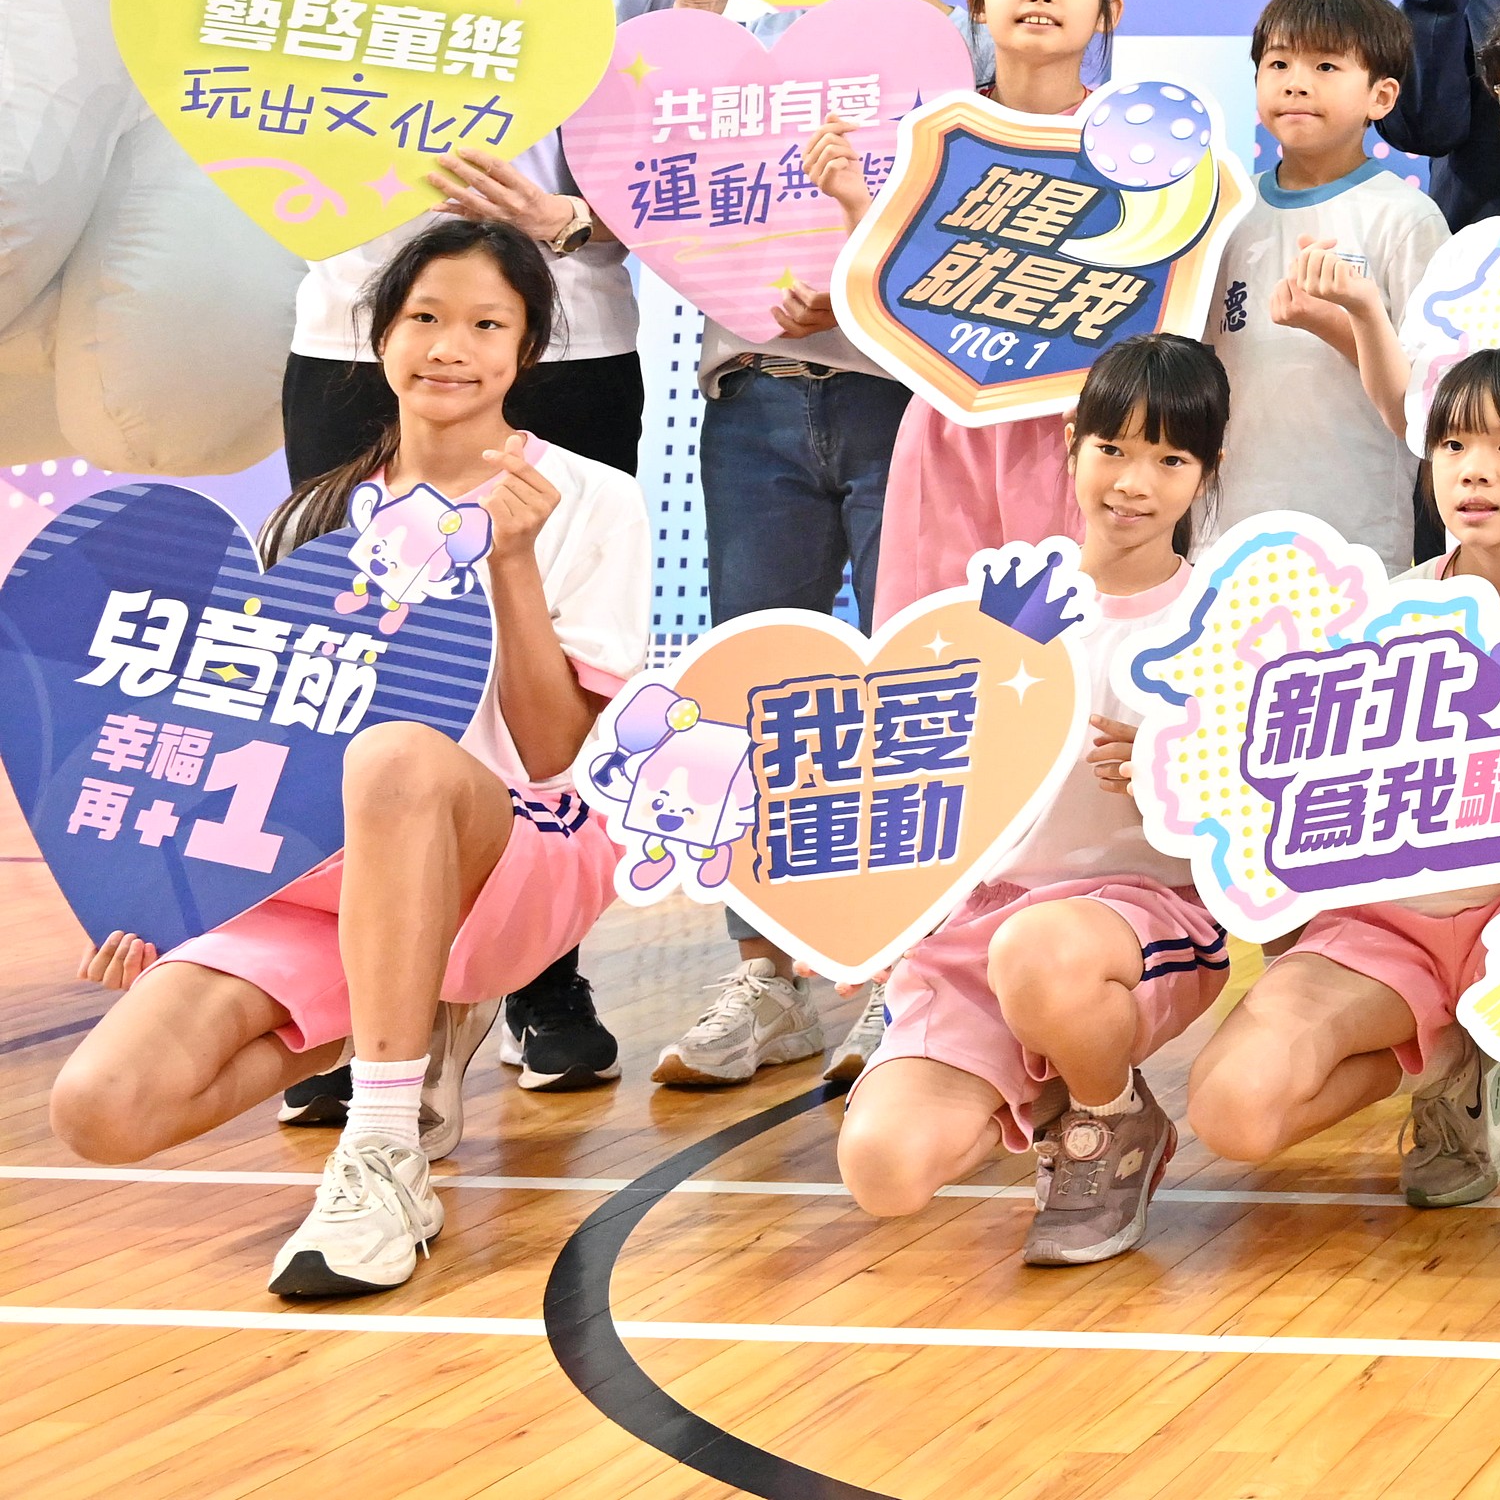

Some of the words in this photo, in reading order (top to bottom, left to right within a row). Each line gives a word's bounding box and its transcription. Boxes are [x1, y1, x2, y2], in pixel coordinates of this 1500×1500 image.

[180, 63, 514, 155] 玩出文化力
[652, 74, 881, 143] 共融有愛
[940, 166, 1099, 247] 球星
[903, 241, 1147, 341] 就是我
[74, 588, 388, 736] 兒童節
[1260, 650, 1466, 766] 新北
[91, 713, 213, 782] 幸福
[755, 662, 981, 790] 我愛
[763, 782, 965, 883] 運動
